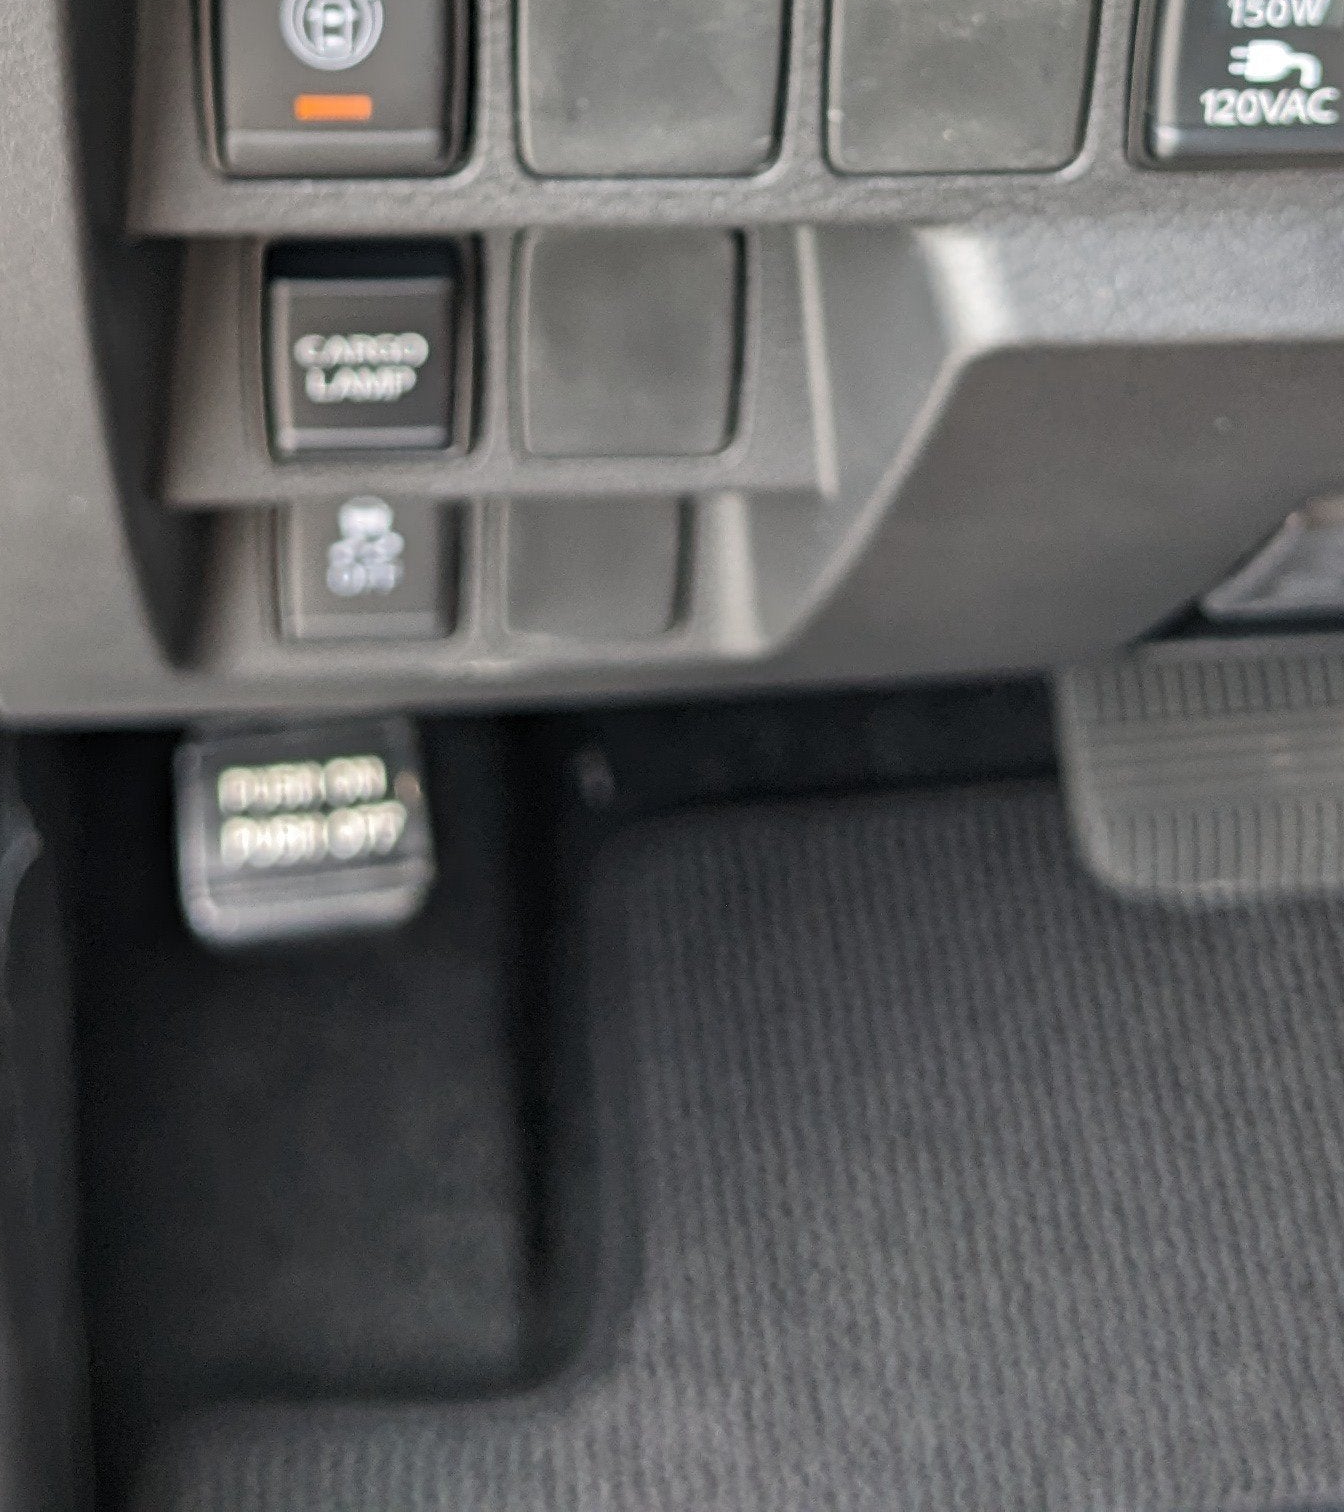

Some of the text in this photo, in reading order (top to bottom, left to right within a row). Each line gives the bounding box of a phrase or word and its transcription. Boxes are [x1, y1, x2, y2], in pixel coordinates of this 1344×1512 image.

[1199, 87, 1342, 126] 120VAC
[294, 332, 429, 368] CARGO
[305, 365, 417, 403] LAMP
